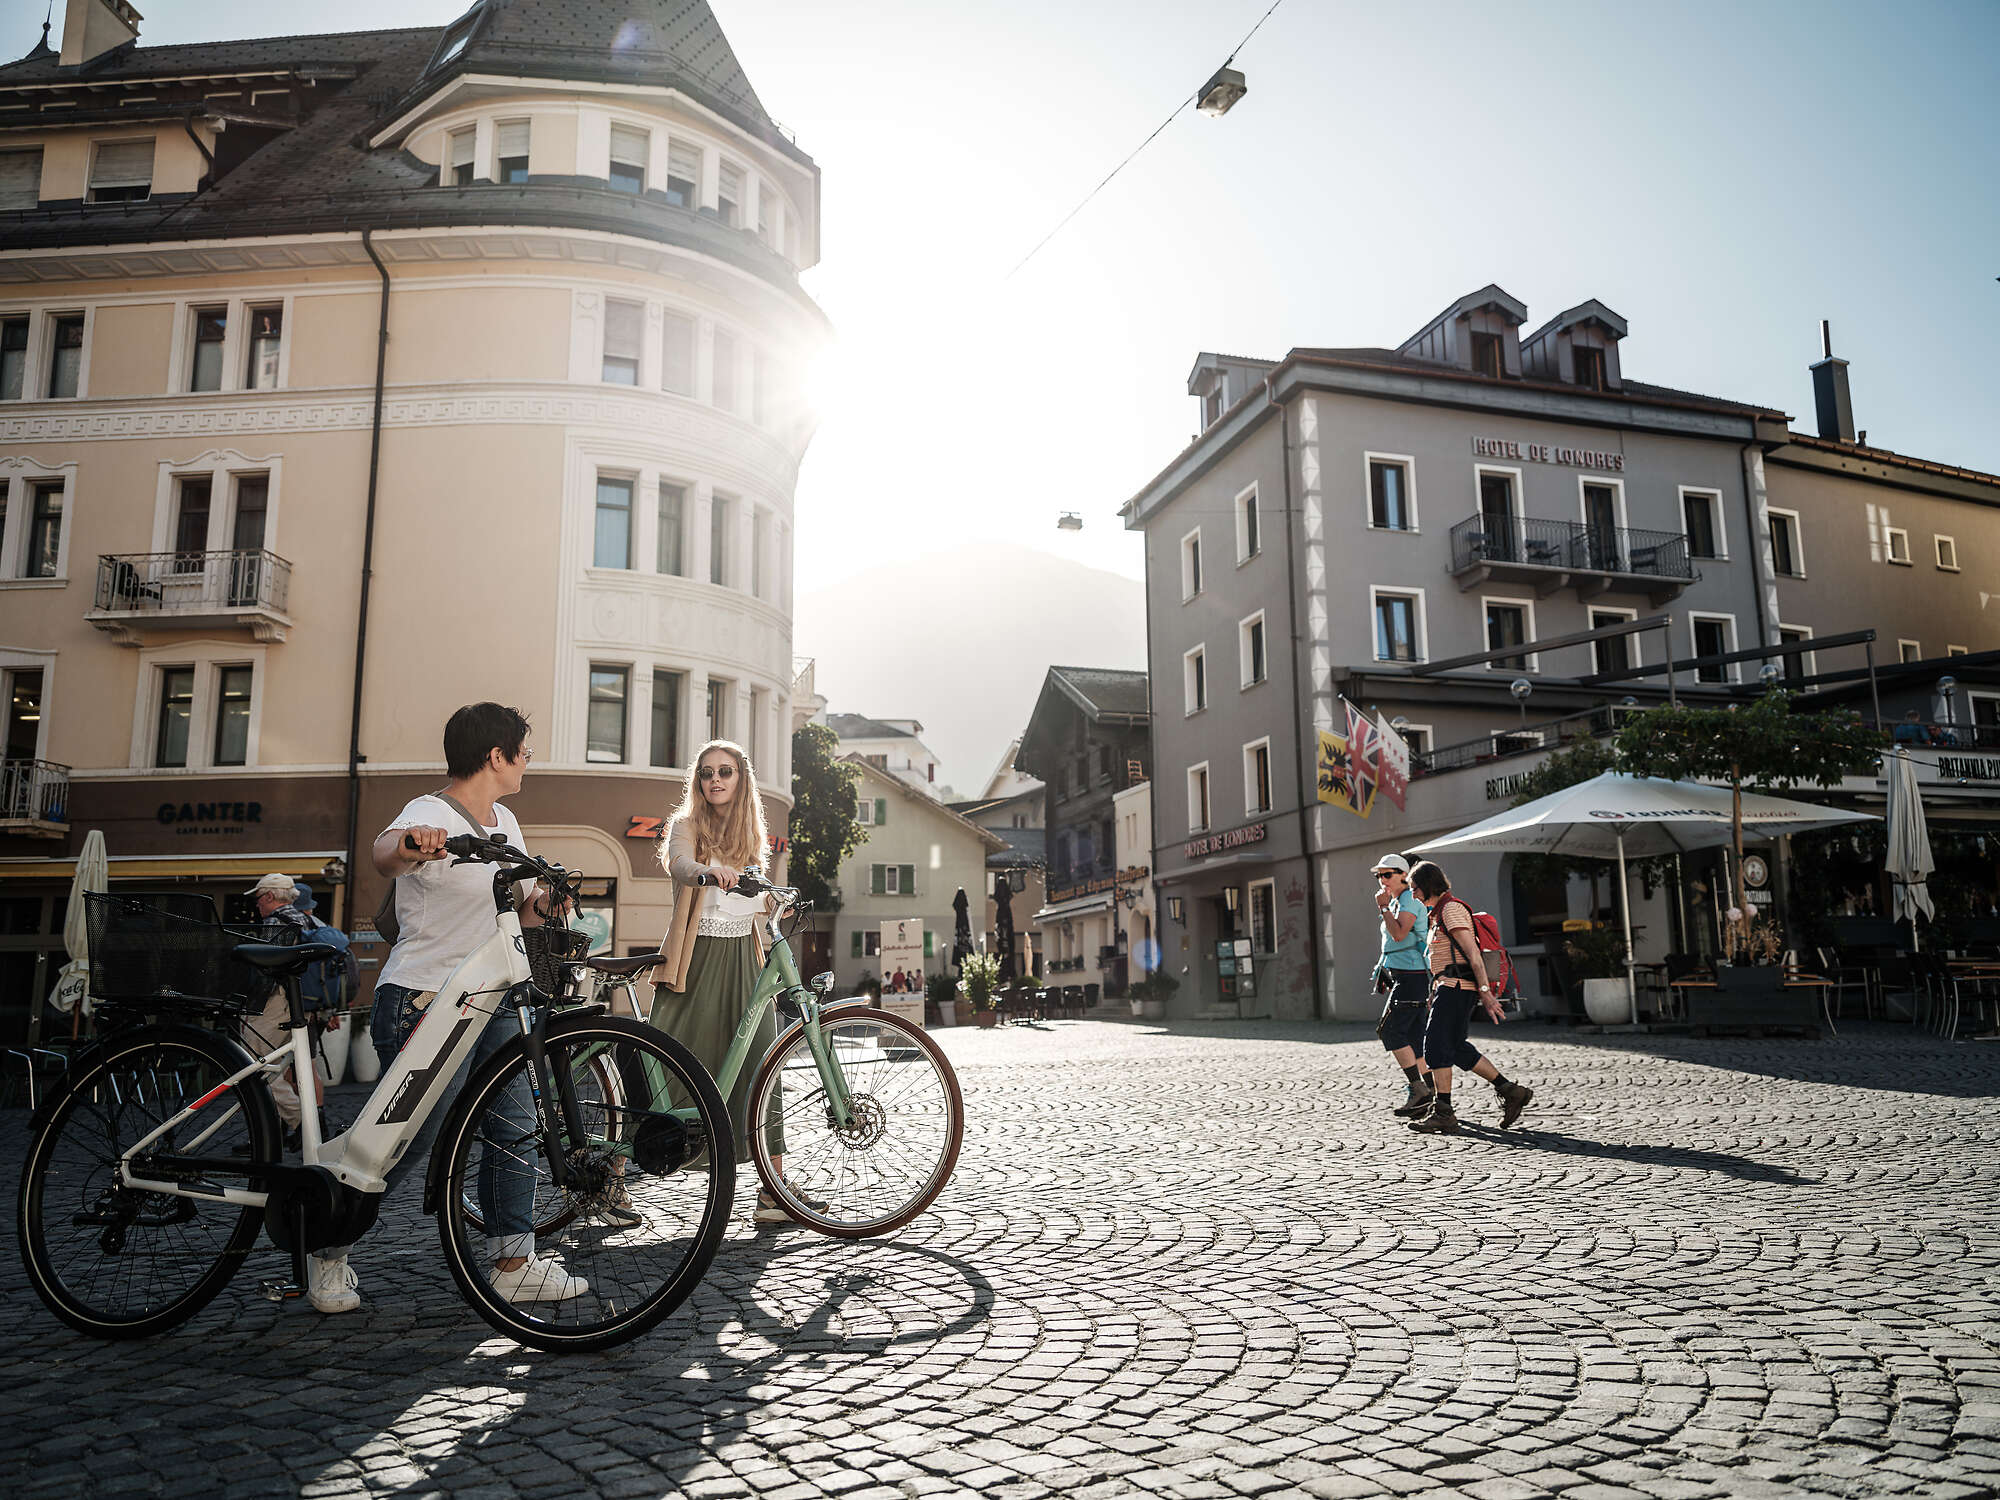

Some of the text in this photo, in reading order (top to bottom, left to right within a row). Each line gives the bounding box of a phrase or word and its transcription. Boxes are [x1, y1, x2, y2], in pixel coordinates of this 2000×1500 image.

[1478, 437, 1625, 471] HOTEL DE LONDRES
[1938, 756, 1987, 779] BRITANNIA
[157, 801, 263, 824] GANTER
[1184, 823, 1265, 858] HOTEL DE LONDRES
[383, 1072, 415, 1122] VIPER
